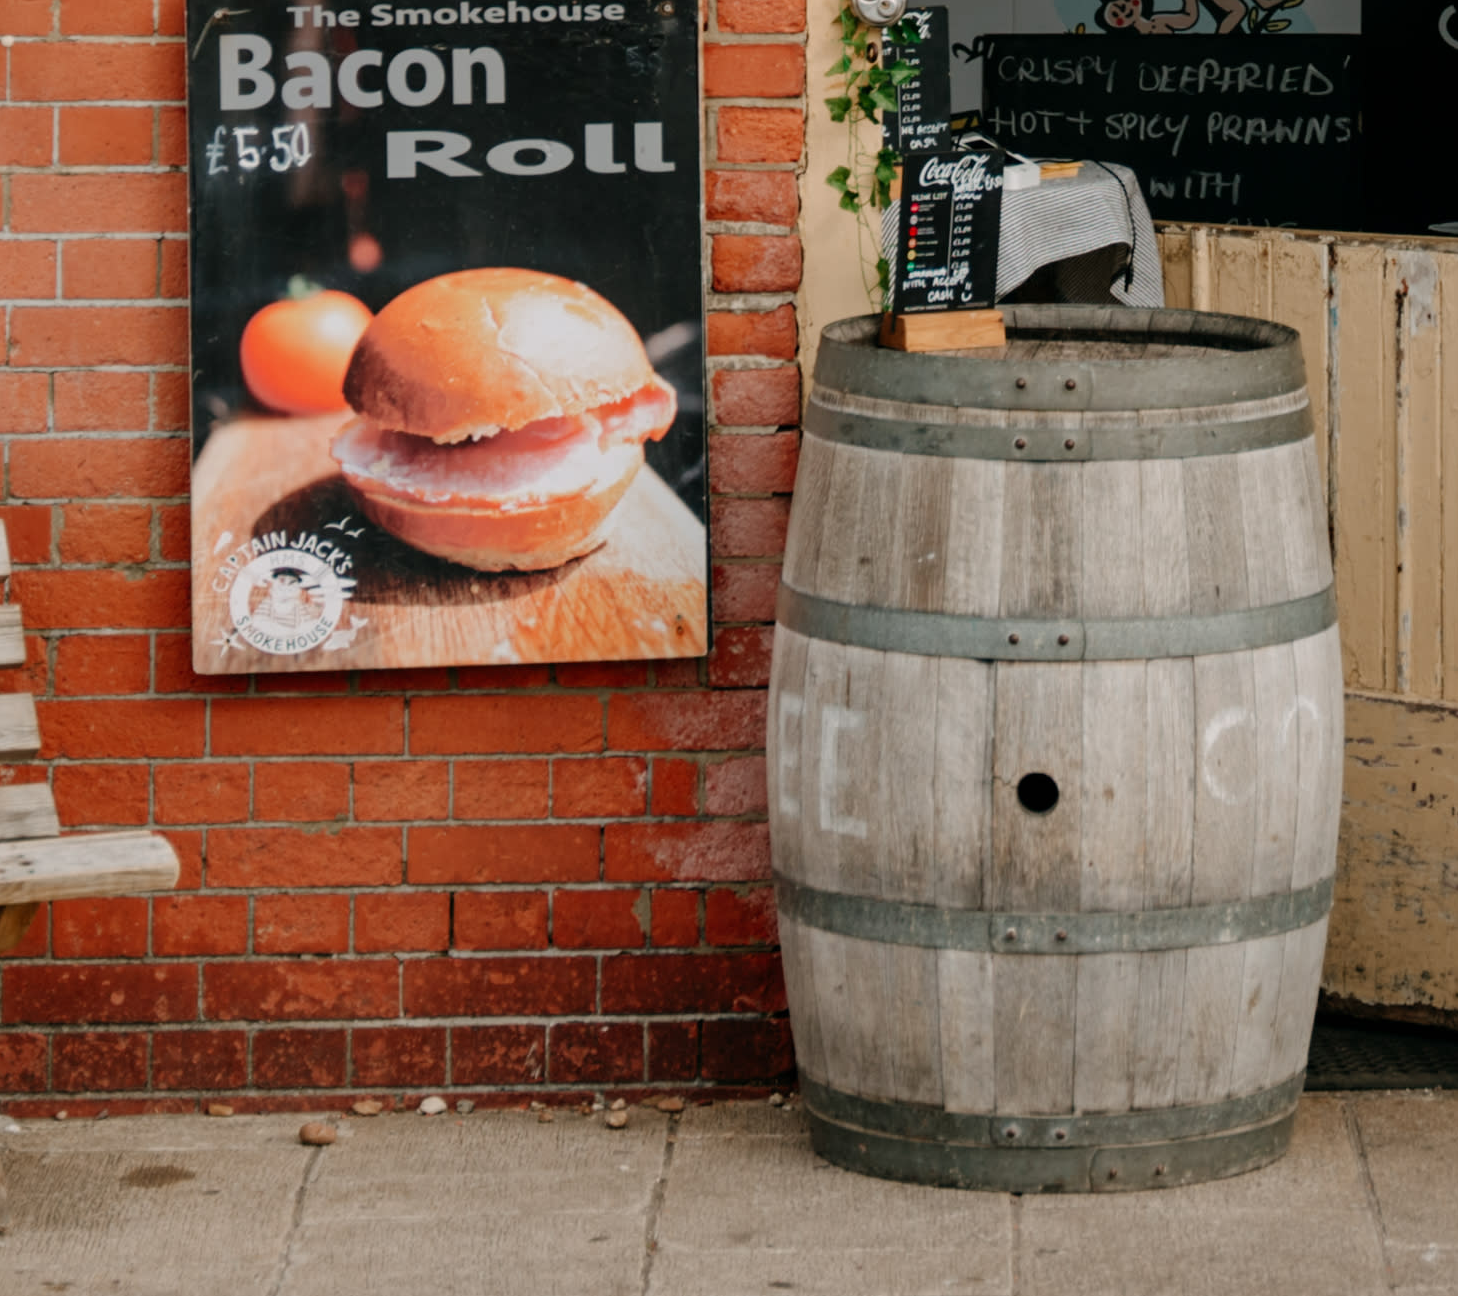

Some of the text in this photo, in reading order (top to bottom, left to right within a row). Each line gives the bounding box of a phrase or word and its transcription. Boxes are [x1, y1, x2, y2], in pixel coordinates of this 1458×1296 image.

[288, 0, 625, 29] The Smokehouse
[219, 33, 507, 111] Bacon
[205, 123, 311, 176] £5.50
[387, 122, 675, 179] Roll
[987, 107, 1064, 137] HOT
[1105, 112, 1189, 157] SPICY
[1150, 171, 1241, 206] WITH
[212, 529, 287, 593] CAPTAIN
[236, 615, 333, 652] SMOKEHOUSE
